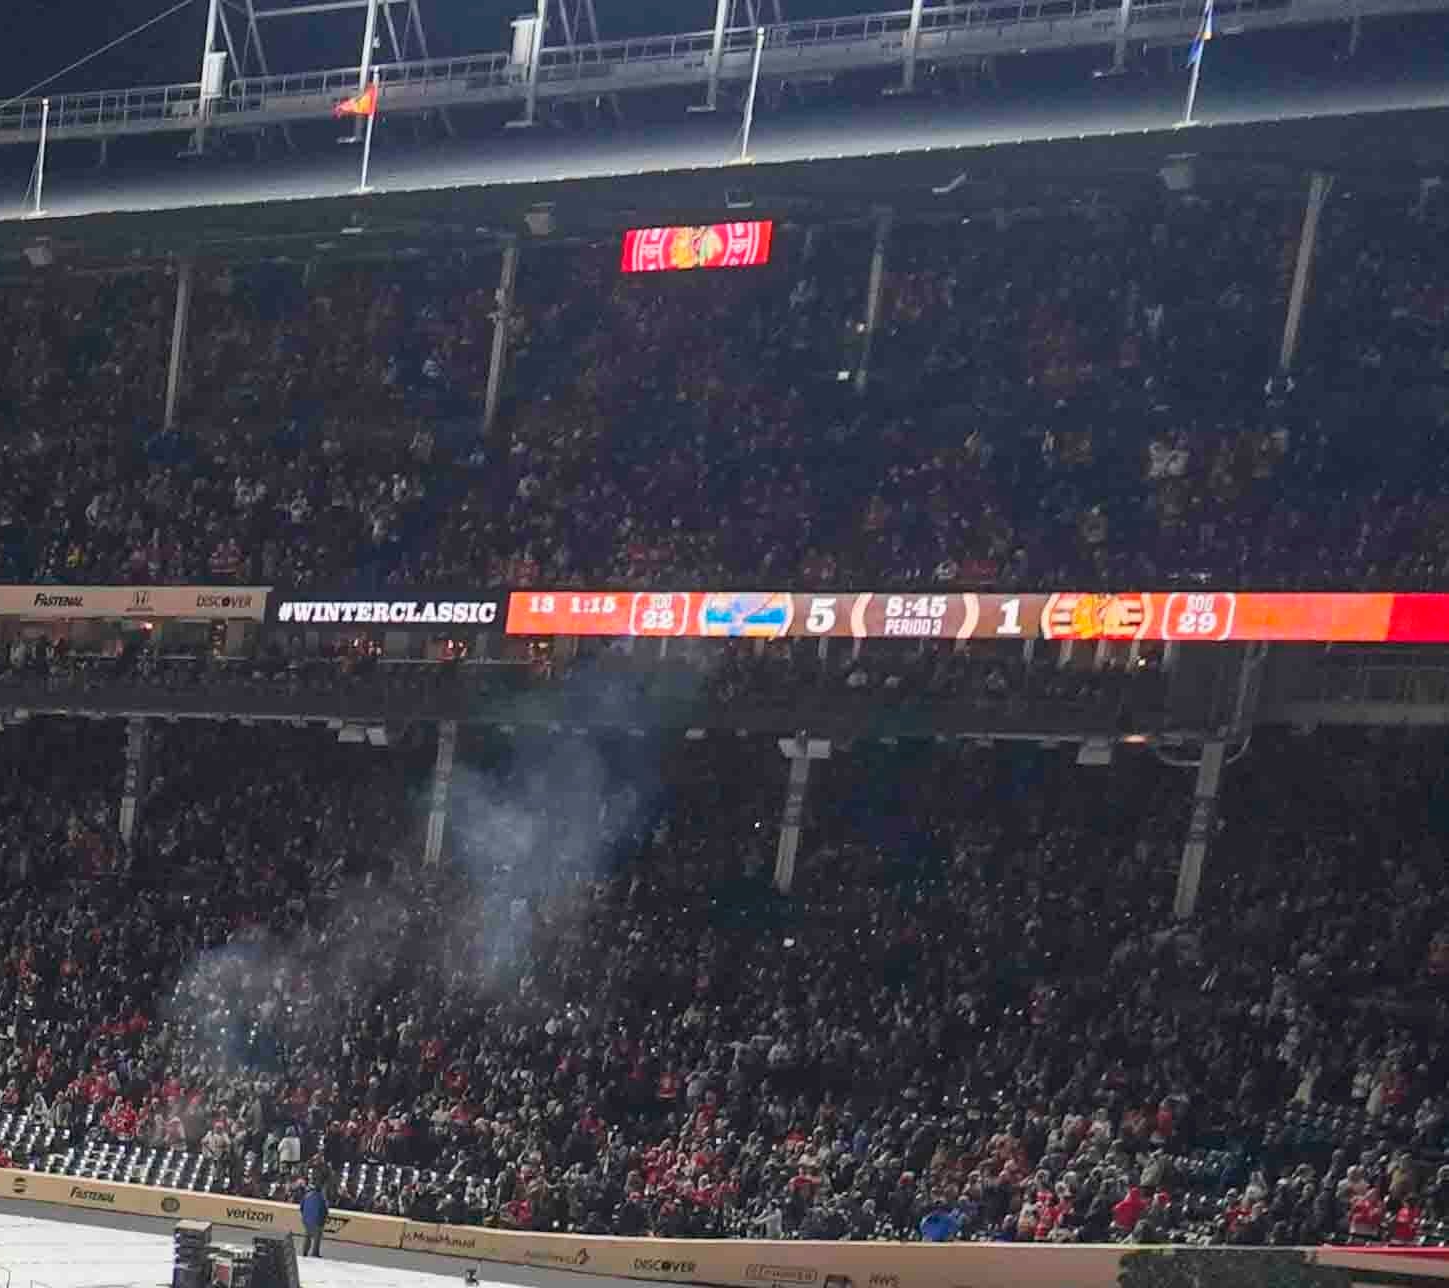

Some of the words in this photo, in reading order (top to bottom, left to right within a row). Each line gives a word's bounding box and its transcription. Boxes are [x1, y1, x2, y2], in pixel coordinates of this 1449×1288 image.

[196, 594, 253, 608] DISCOVER
[885, 596, 947, 617] 8:45
[278, 602, 497, 623] #WINTERCLASSIC
[806, 598, 836, 633] 5
[996, 599, 1022, 634] 1
[884, 619, 930, 635] PERIOD
[1177, 613, 1218, 633] 29
[225, 1207, 274, 1223] verizon
[634, 1257, 696, 1274] DISCOVER
